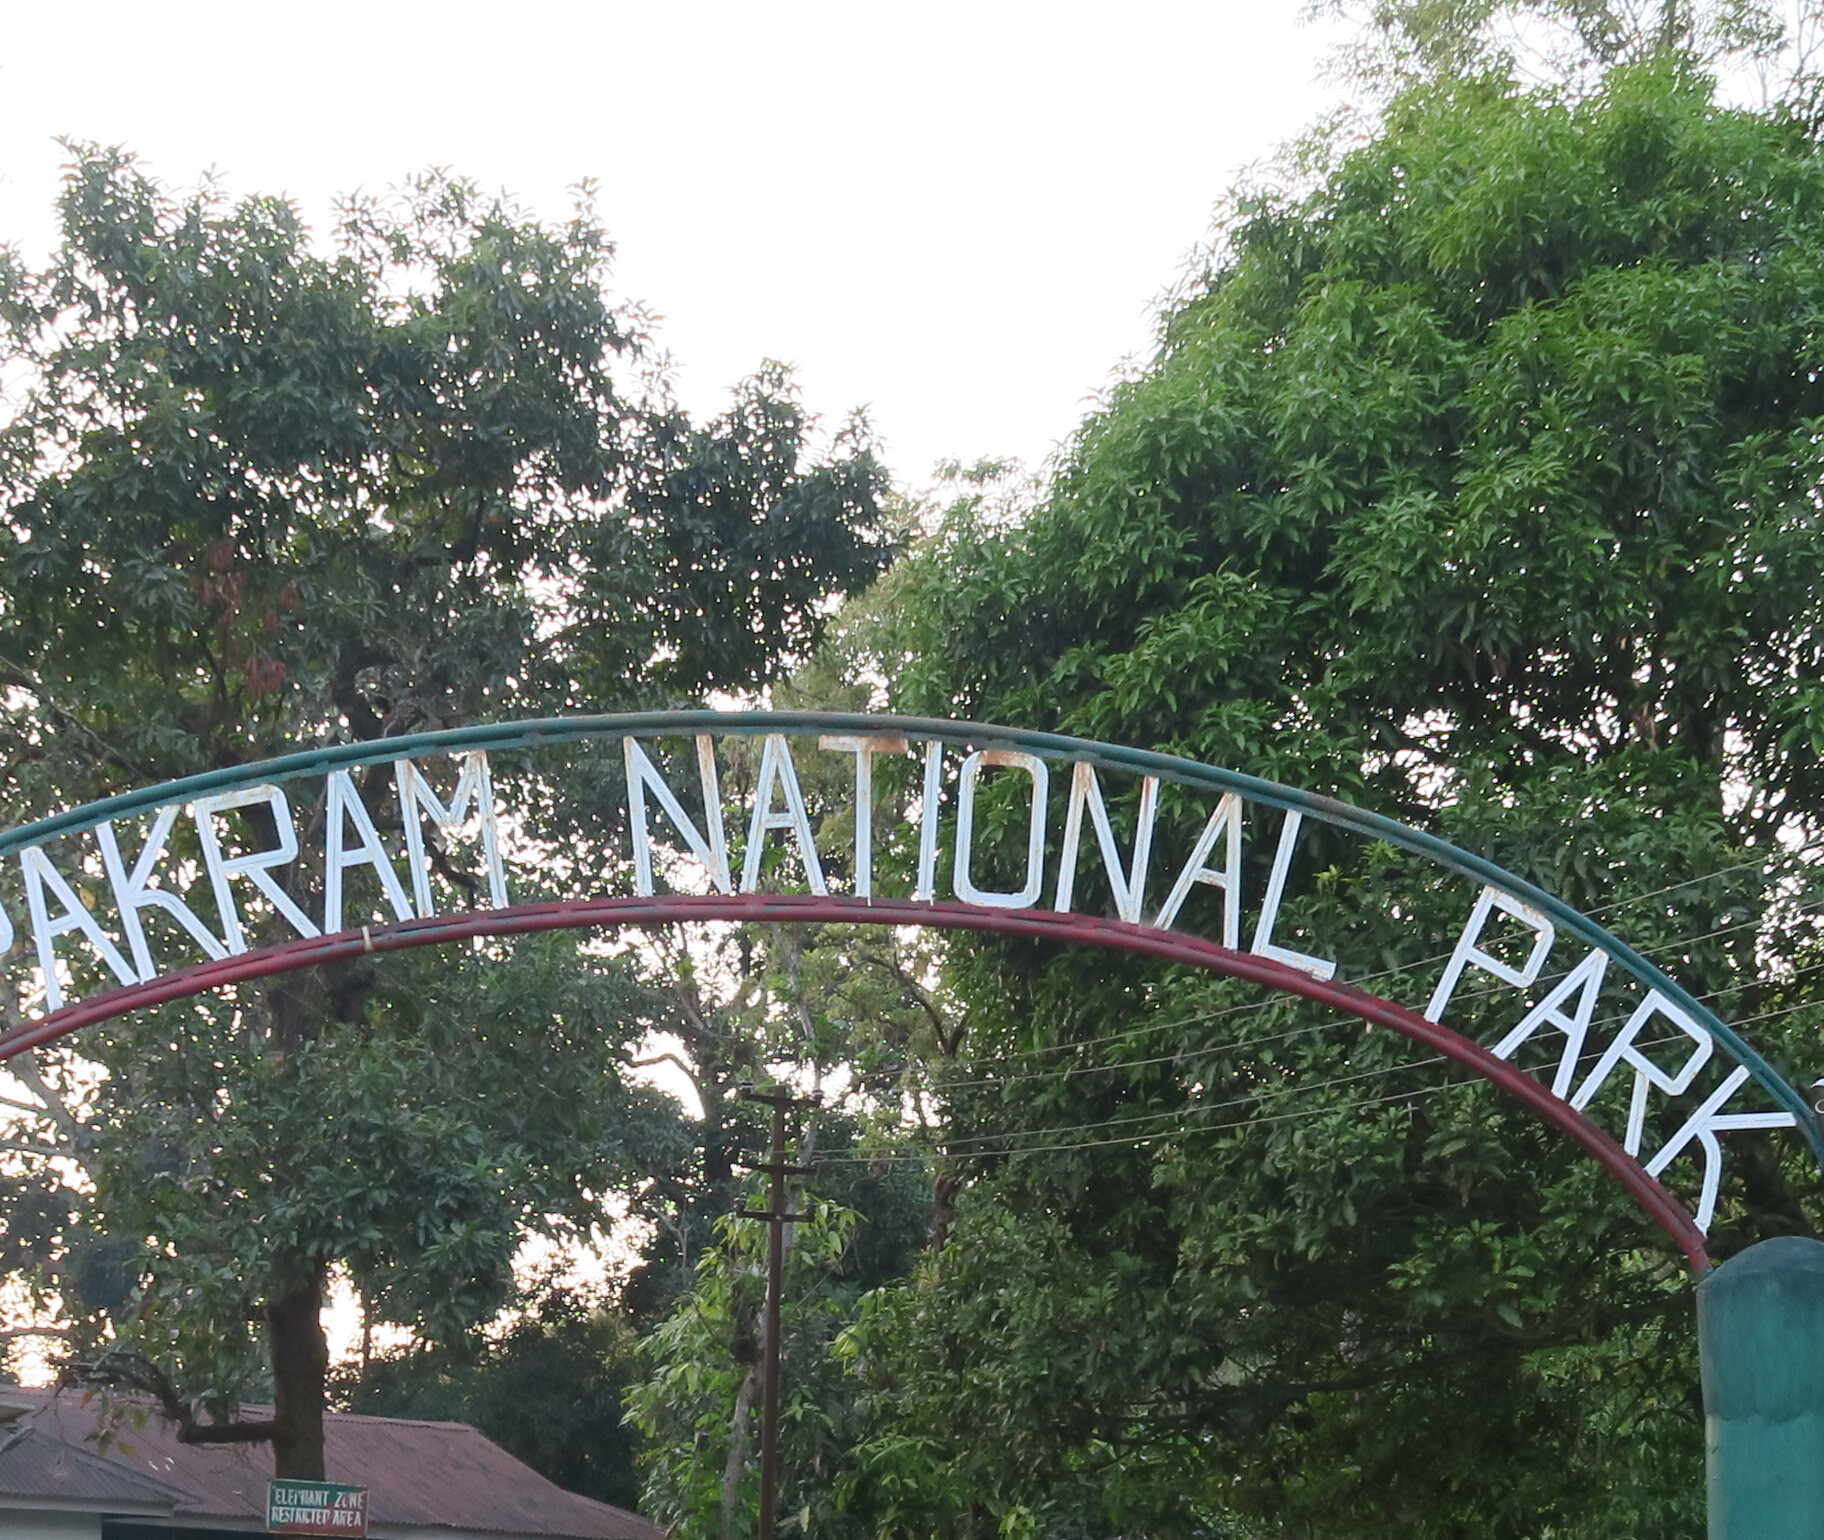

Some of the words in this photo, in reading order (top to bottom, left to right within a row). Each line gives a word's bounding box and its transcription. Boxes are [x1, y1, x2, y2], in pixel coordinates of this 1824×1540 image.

[623, 734, 1336, 981] NATIONAL
[1425, 886, 1796, 1238] PARK
[332, 1510, 361, 1527] AREA
